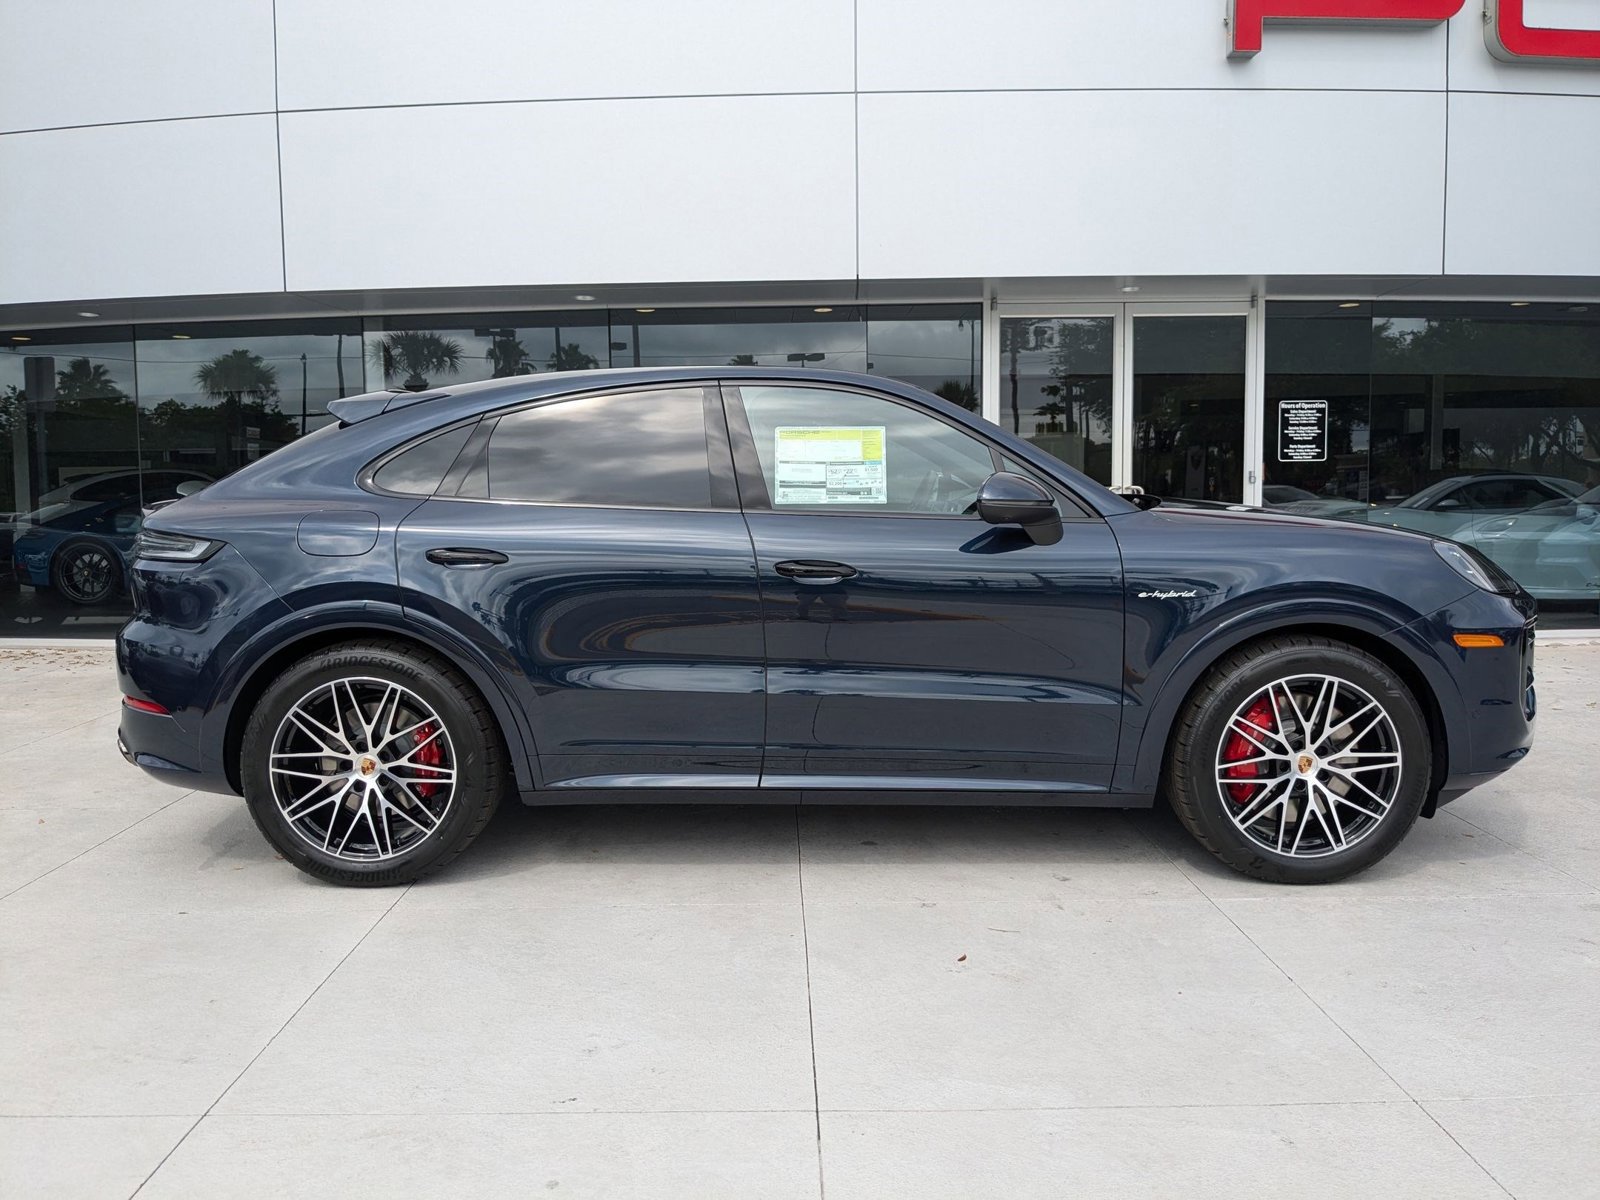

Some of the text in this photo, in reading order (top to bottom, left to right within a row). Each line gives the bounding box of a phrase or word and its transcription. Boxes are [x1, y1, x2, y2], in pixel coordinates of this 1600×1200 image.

[1138, 589, 1197, 601] e-hybrid
[320, 655, 424, 681] BRIDGESTONE
[304, 858, 402, 882] BRIDGESTONE
